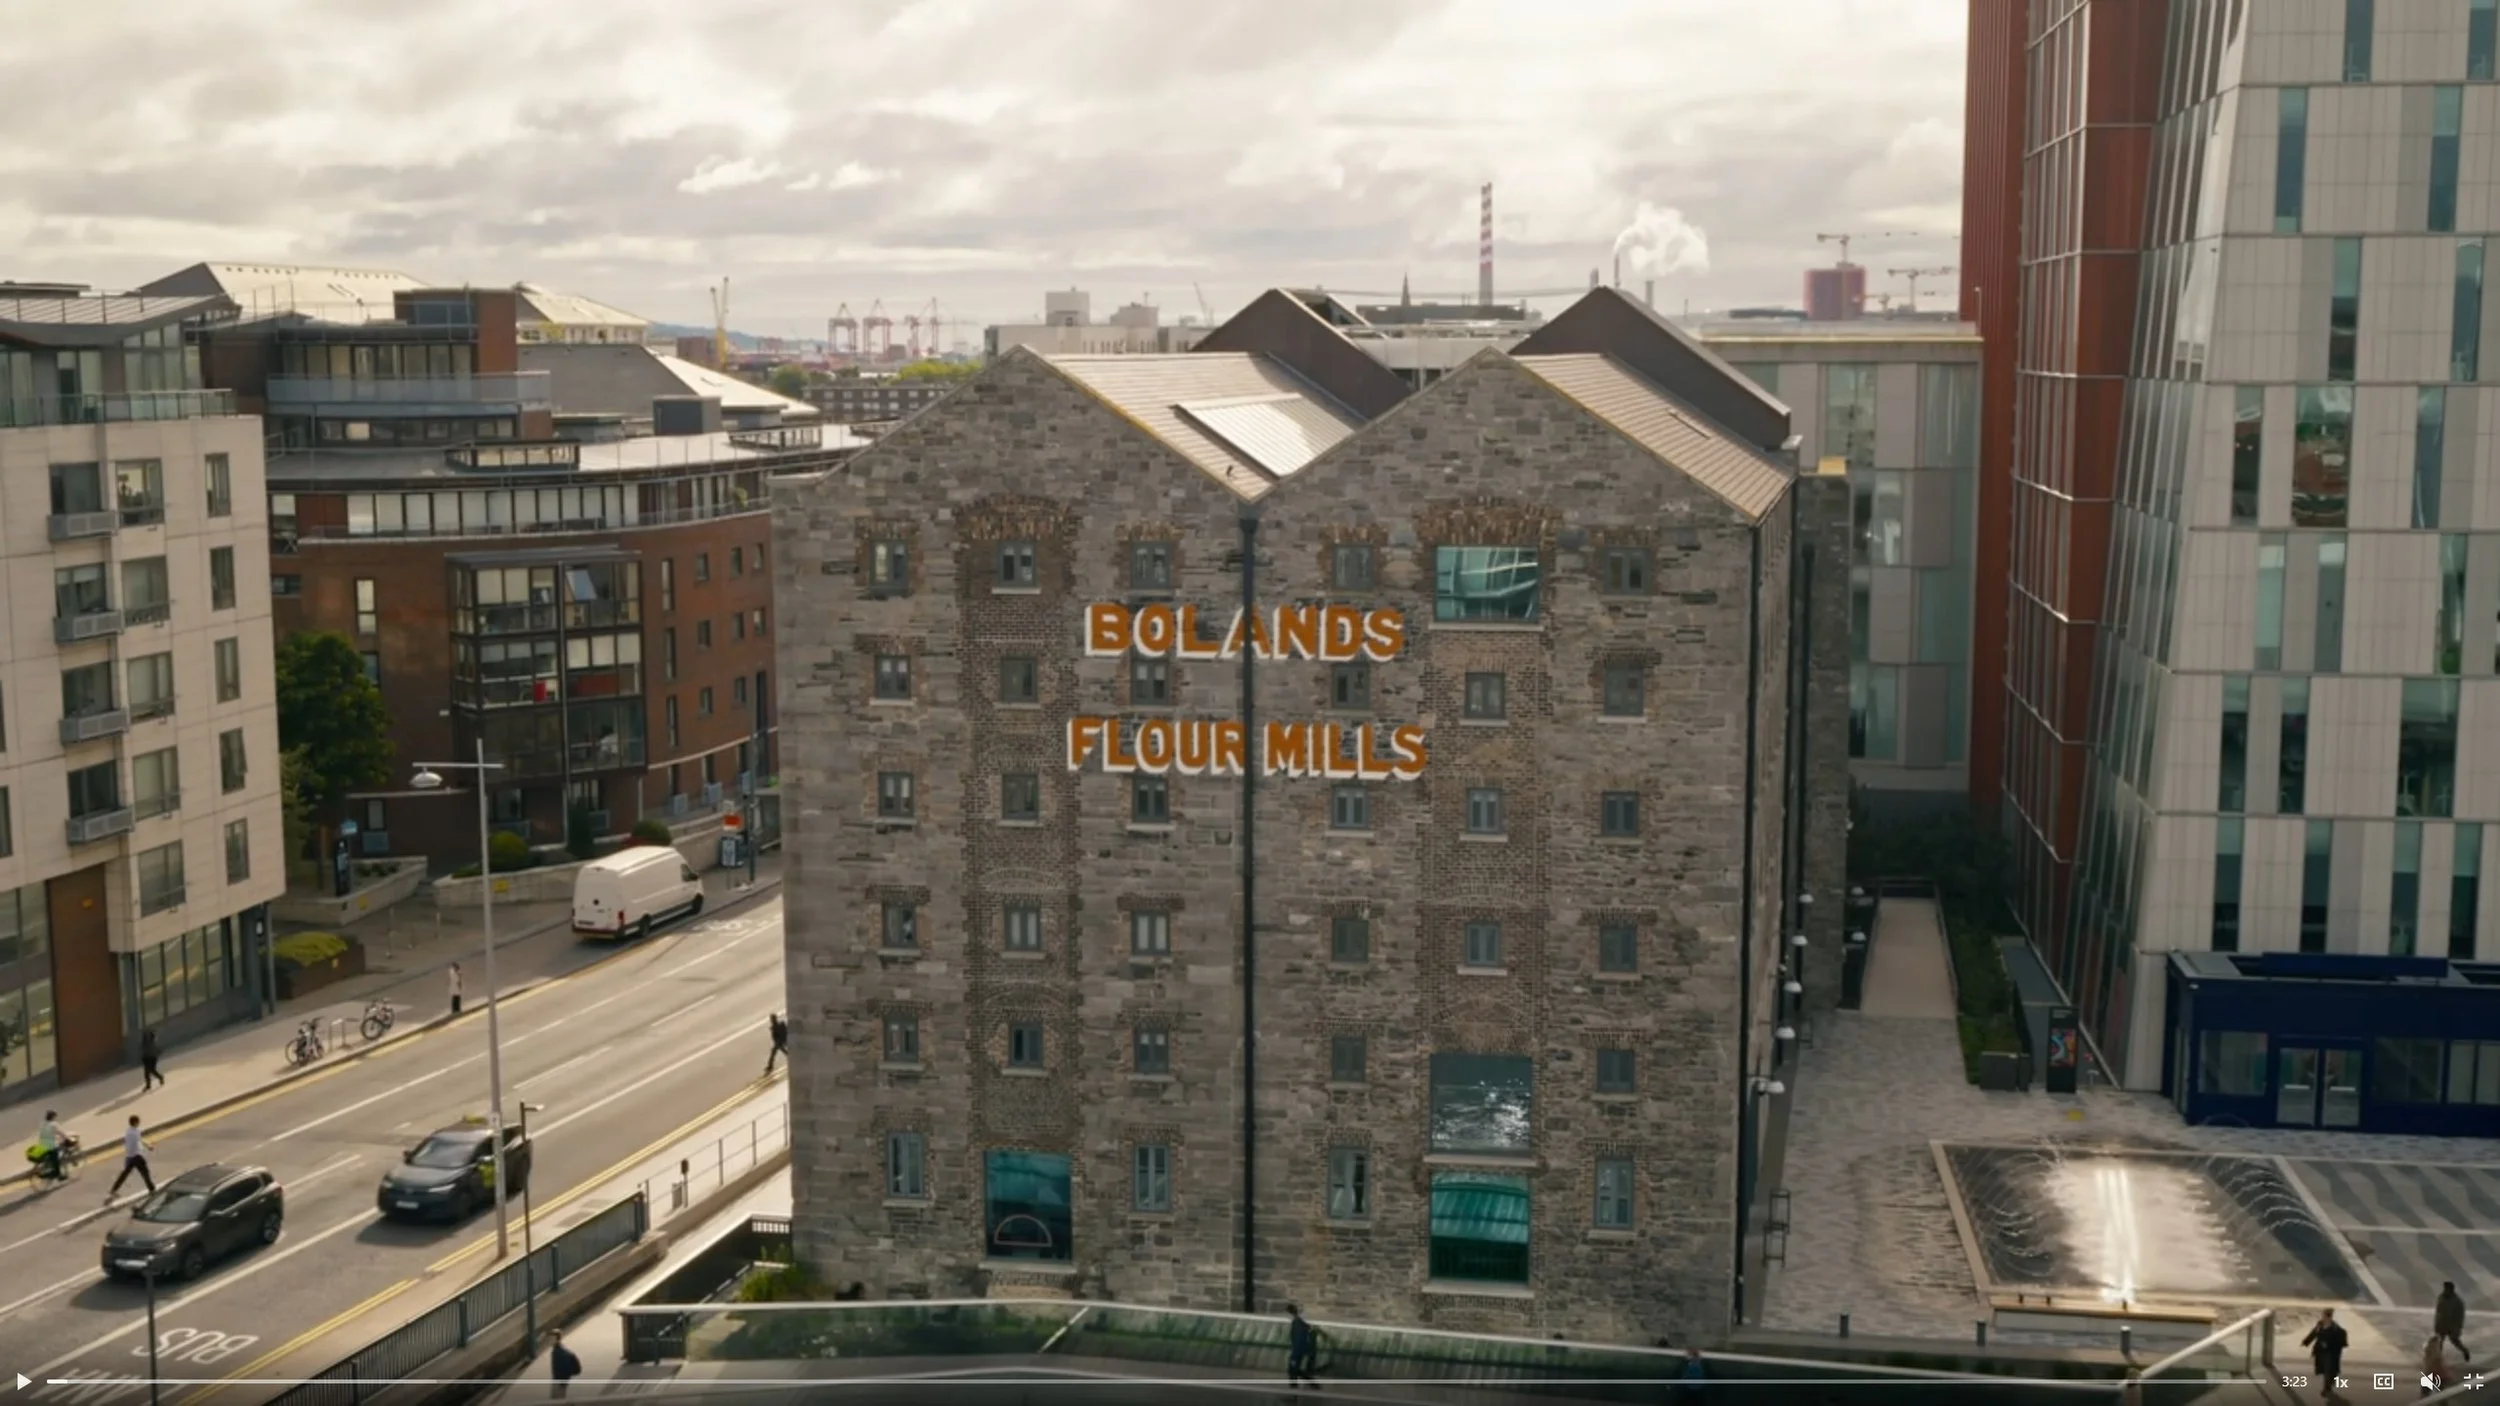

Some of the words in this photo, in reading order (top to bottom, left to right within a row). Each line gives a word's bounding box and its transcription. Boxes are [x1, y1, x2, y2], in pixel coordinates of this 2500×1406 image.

[1084, 602, 1405, 662] BOLANDS
[1066, 717, 1244, 776] FLOUR
[1263, 720, 1428, 780] MILLS
[131, 1327, 259, 1364] BUS
